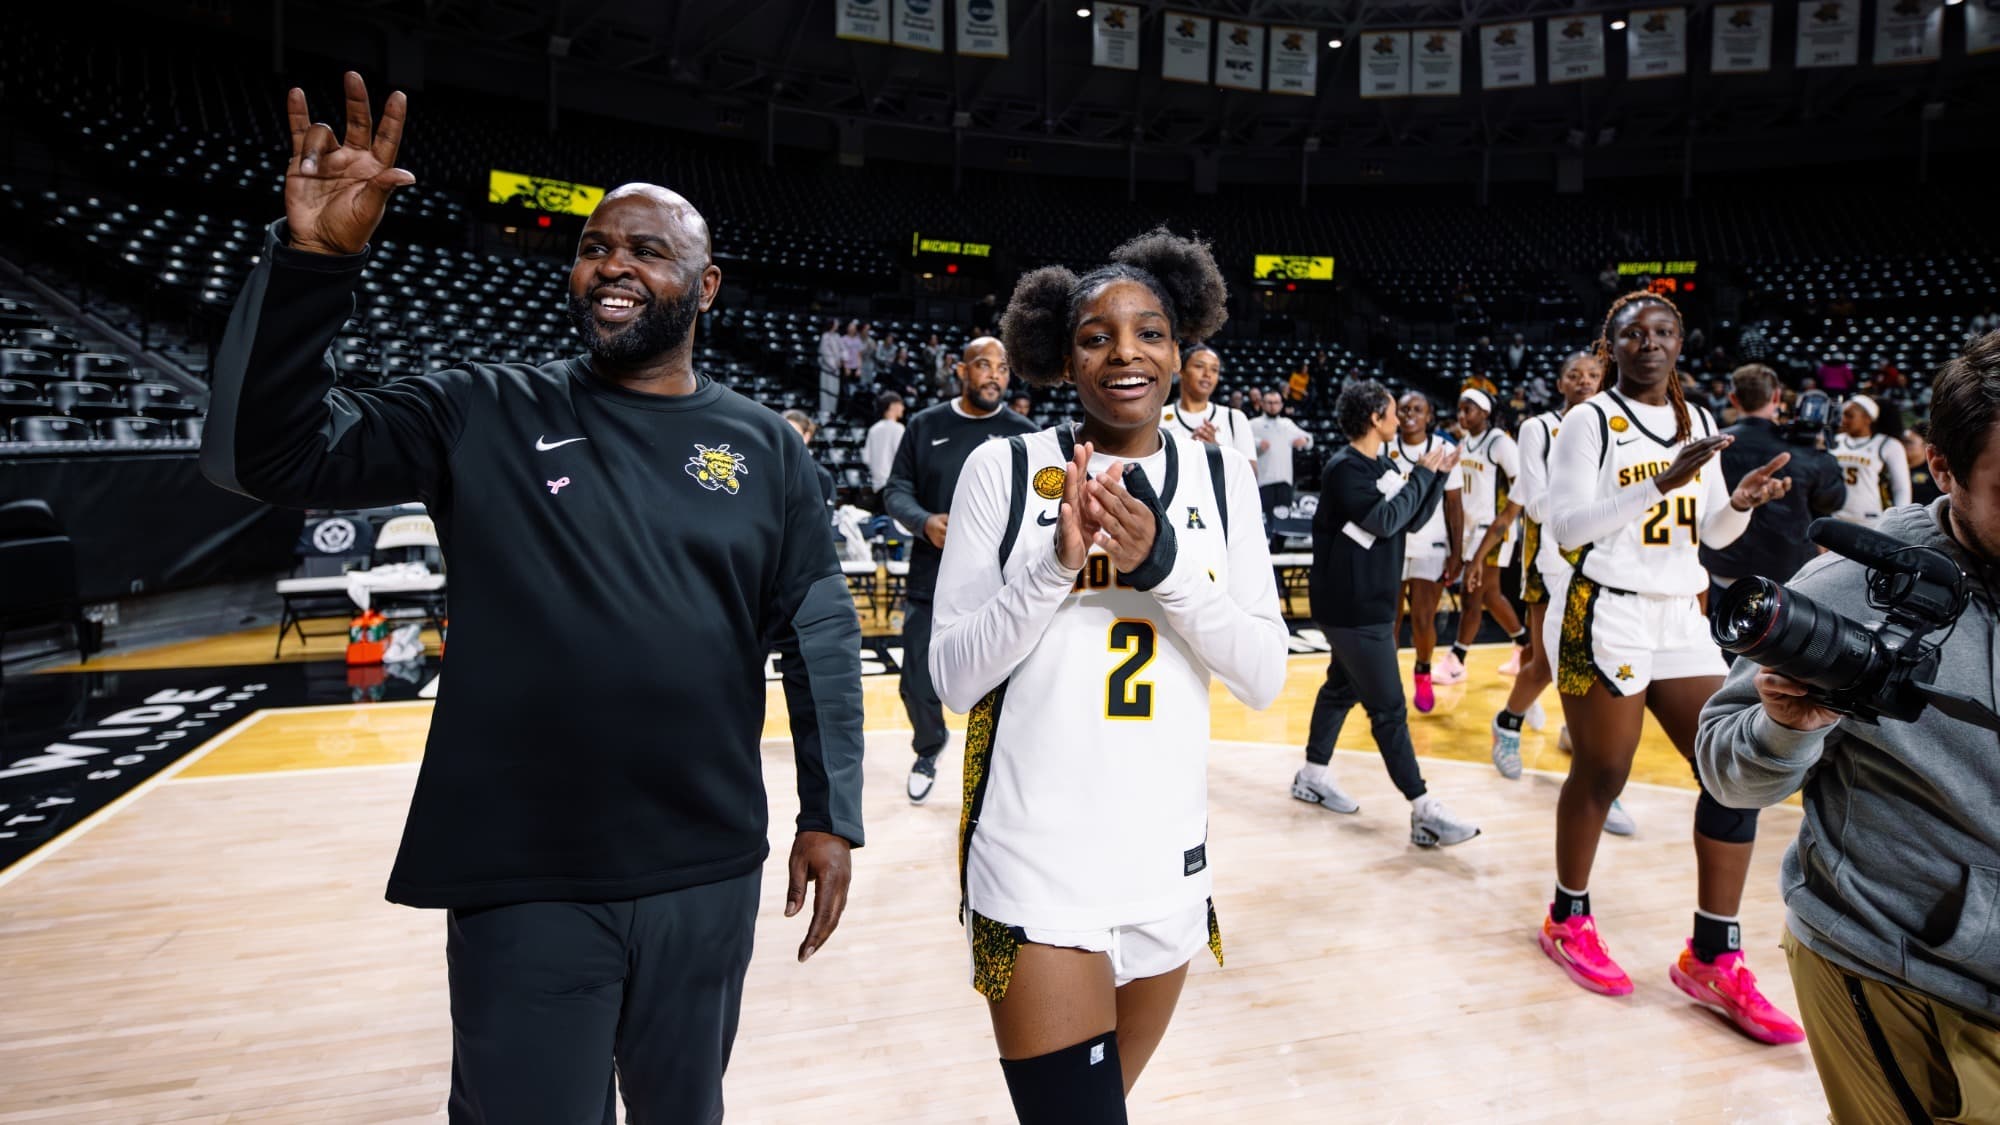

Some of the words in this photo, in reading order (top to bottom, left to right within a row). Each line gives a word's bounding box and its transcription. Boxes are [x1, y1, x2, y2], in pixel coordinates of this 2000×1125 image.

[920, 239, 961, 254] WICHITA
[962, 243, 992, 257] STATE
[1640, 496, 1698, 546] 24
[1106, 619, 1157, 720] 2
[0, 687, 227, 779] WIDE
[87, 683, 268, 780] SOLUTIONS
